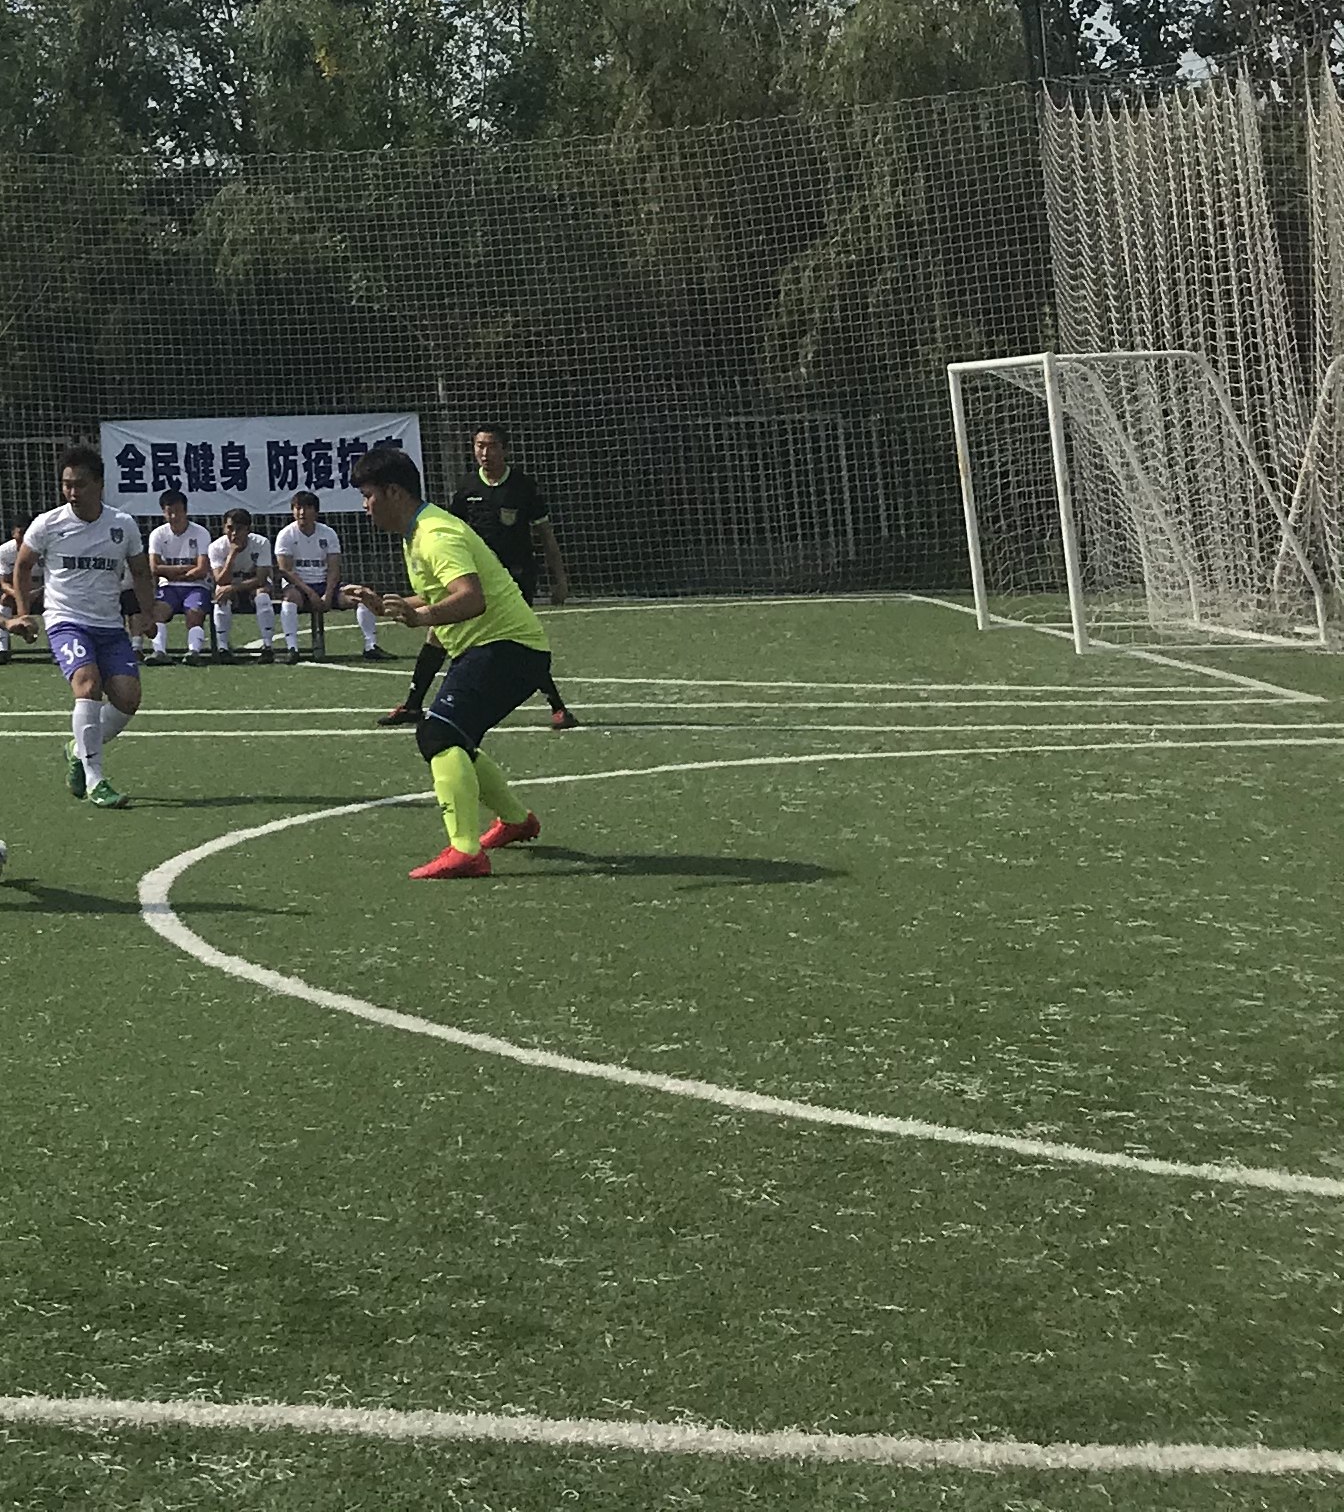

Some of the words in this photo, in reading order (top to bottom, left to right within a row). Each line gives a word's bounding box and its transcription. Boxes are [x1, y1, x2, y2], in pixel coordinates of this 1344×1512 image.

[115, 440, 250, 493] 全民健身
[267, 435, 404, 491] 防疫抗
[60, 638, 87, 665] 36
